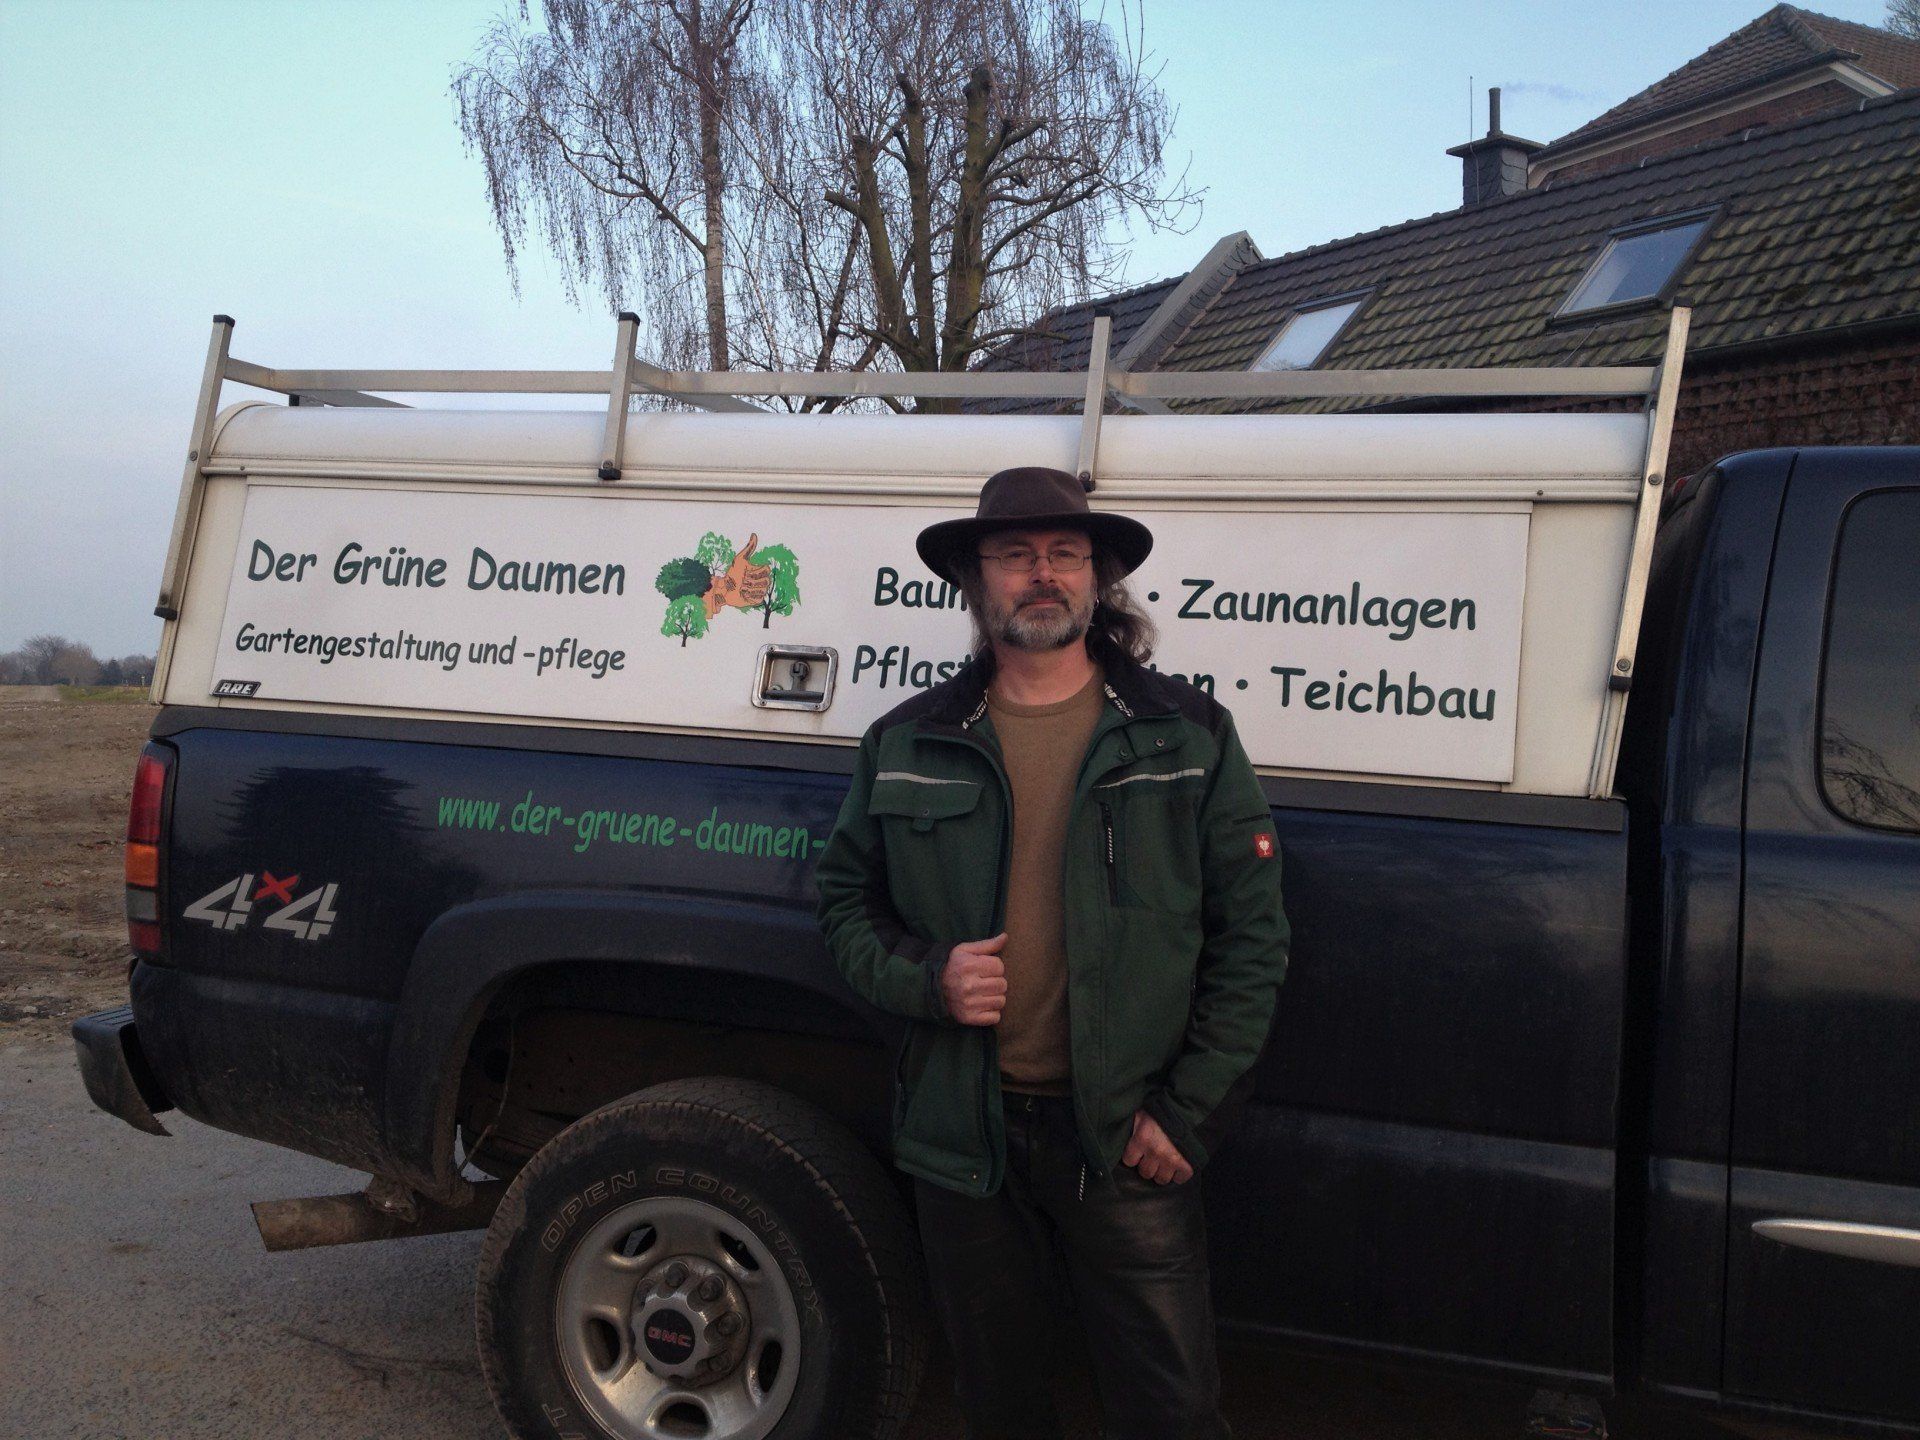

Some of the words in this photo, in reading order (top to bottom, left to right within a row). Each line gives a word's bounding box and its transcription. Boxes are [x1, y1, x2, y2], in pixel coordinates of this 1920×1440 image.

[247, 538, 317, 583] Der
[333, 541, 447, 588] Grüne
[467, 546, 626, 596] Daumen
[1178, 578, 1476, 642] Zaunanlagen
[235, 622, 462, 672] Gartengestaltung
[468, 635, 517, 665] und
[523, 637, 626, 680] -pflege
[1270, 665, 1496, 722] Teichbau
[540, 1169, 638, 1253] OPEN
[654, 1167, 824, 1325] COUNTRY
[647, 1326, 692, 1348] GMC
